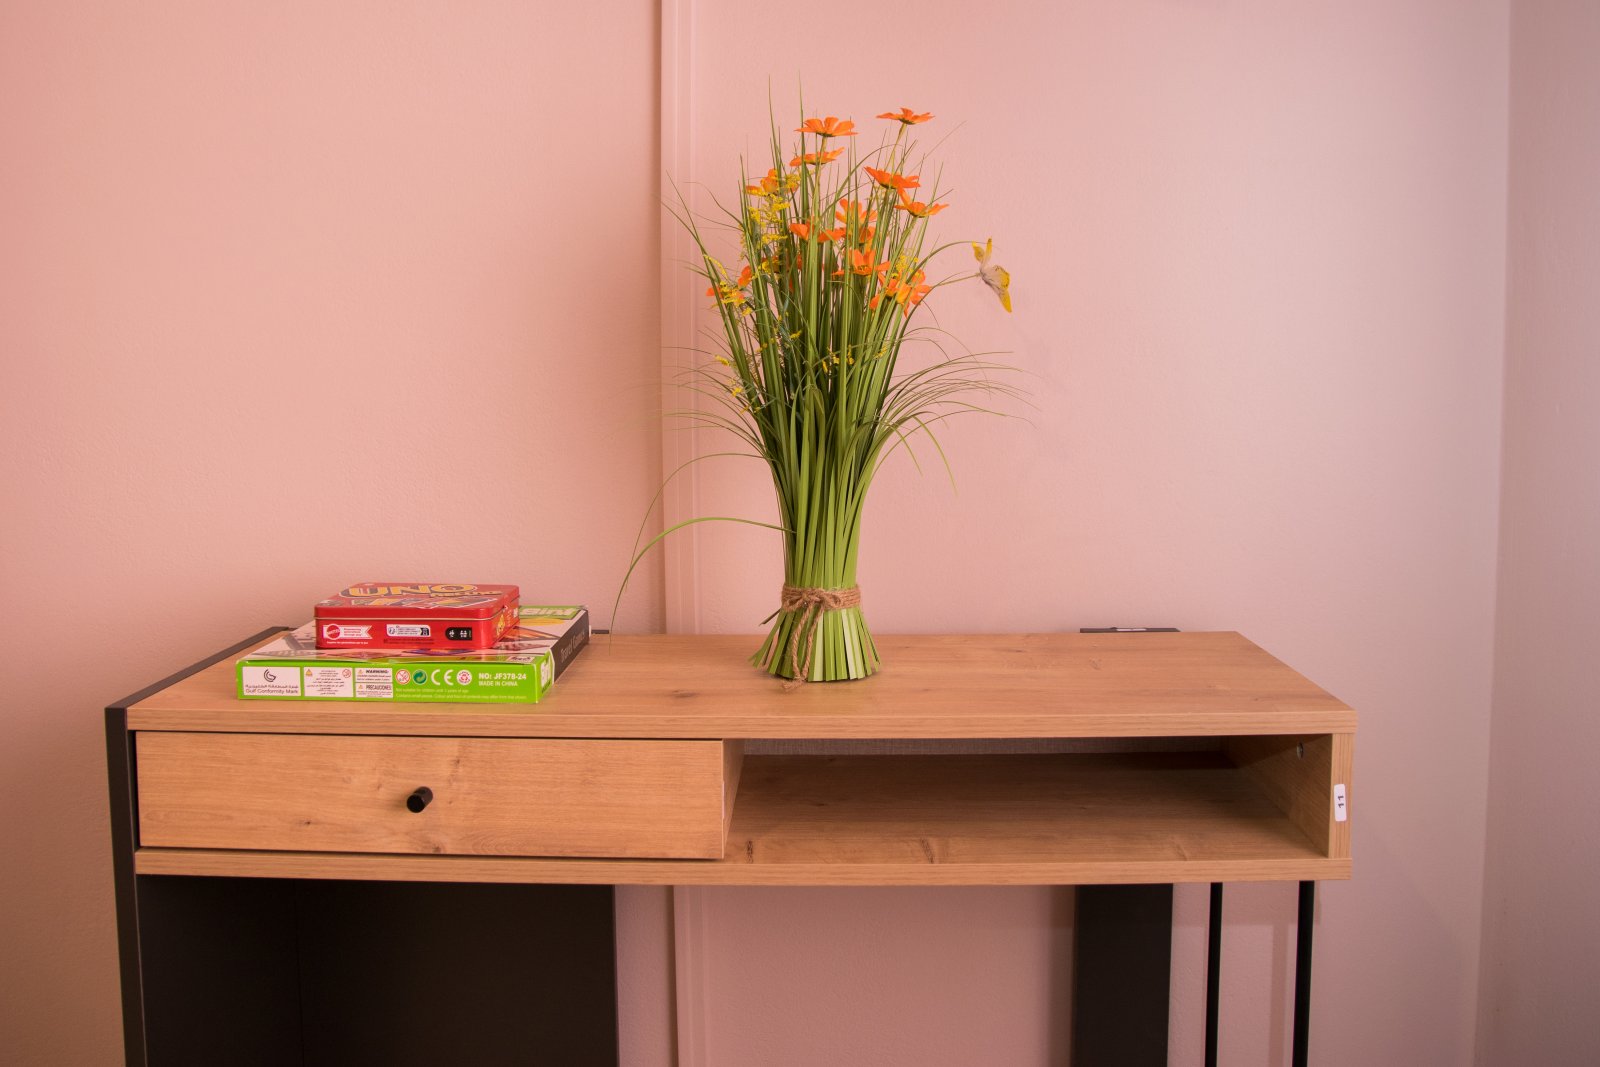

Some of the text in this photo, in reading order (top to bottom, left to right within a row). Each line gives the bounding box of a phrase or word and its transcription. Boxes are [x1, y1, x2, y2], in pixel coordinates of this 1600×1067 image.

[347, 583, 476, 597] UNO
[478, 672, 492, 680] NO:
[1338, 796, 1344, 808] 11
